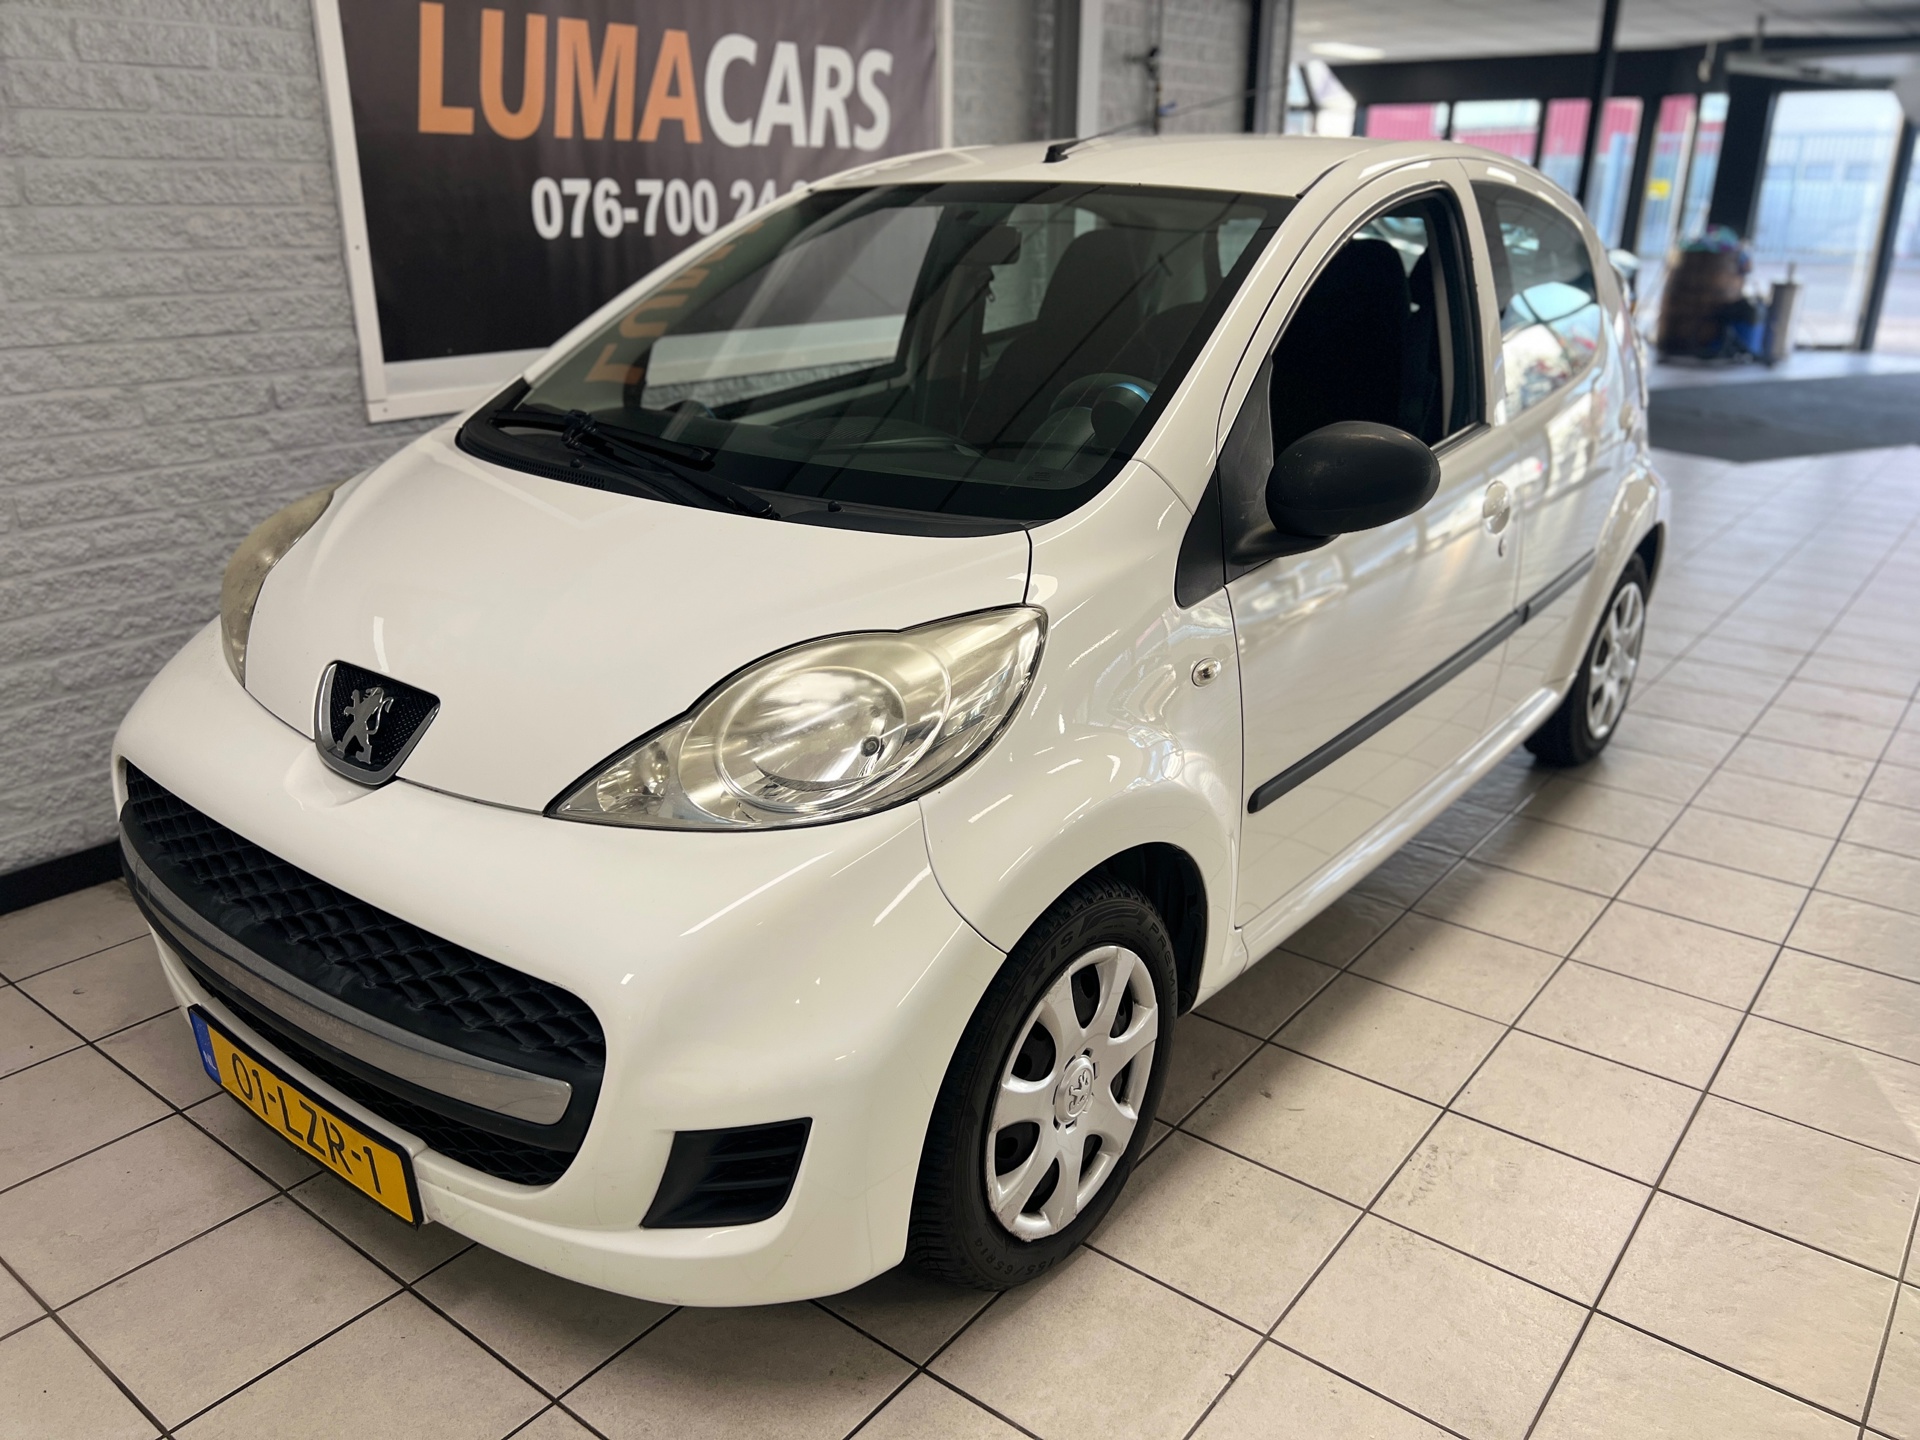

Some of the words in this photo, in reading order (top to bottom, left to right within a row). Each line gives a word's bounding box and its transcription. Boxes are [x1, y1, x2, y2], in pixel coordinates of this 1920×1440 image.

[531, 177, 719, 240] 076-700
[202, 1049, 218, 1071] NL
[231, 1053, 382, 1195] 01-LZR-1
